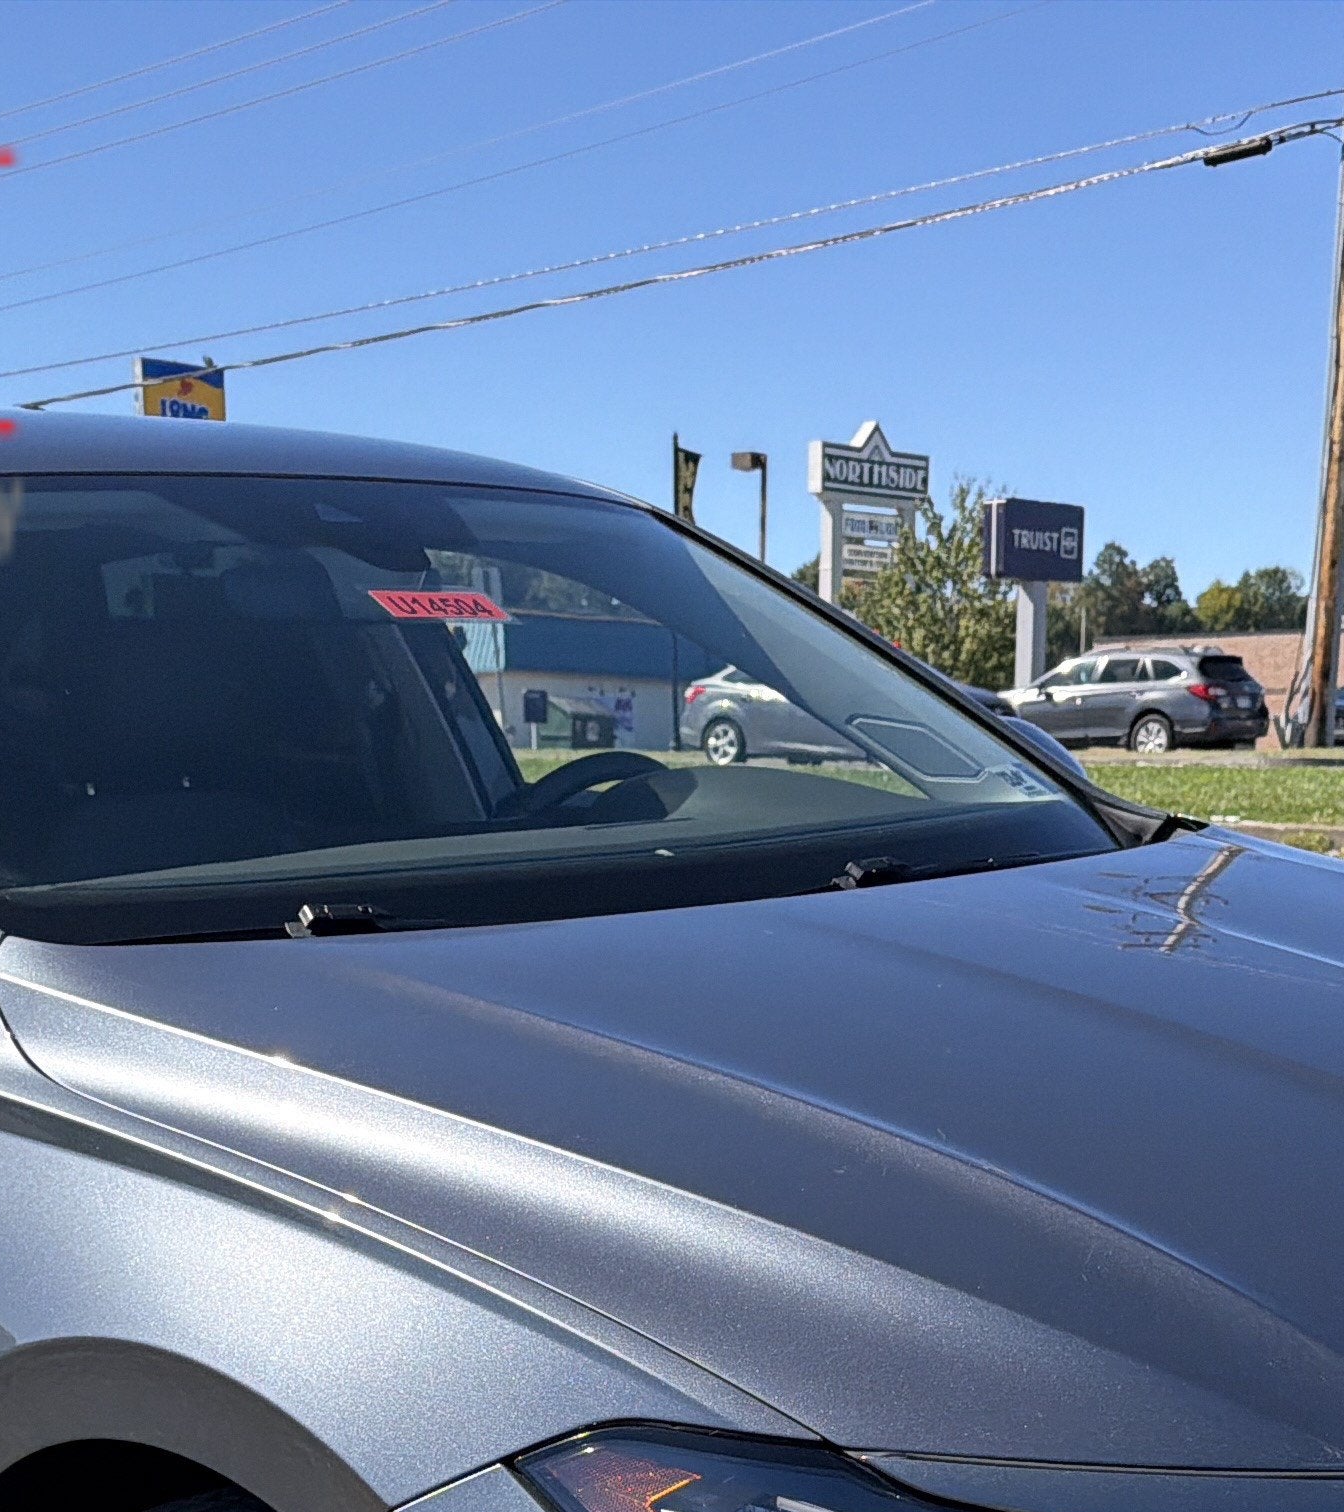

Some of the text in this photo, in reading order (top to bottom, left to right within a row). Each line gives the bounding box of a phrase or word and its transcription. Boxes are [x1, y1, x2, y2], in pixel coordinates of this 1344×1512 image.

[824, 458, 927, 491] NORTHSIDE
[1012, 528, 1059, 552] TRUIST
[386, 596, 495, 617] U14504
